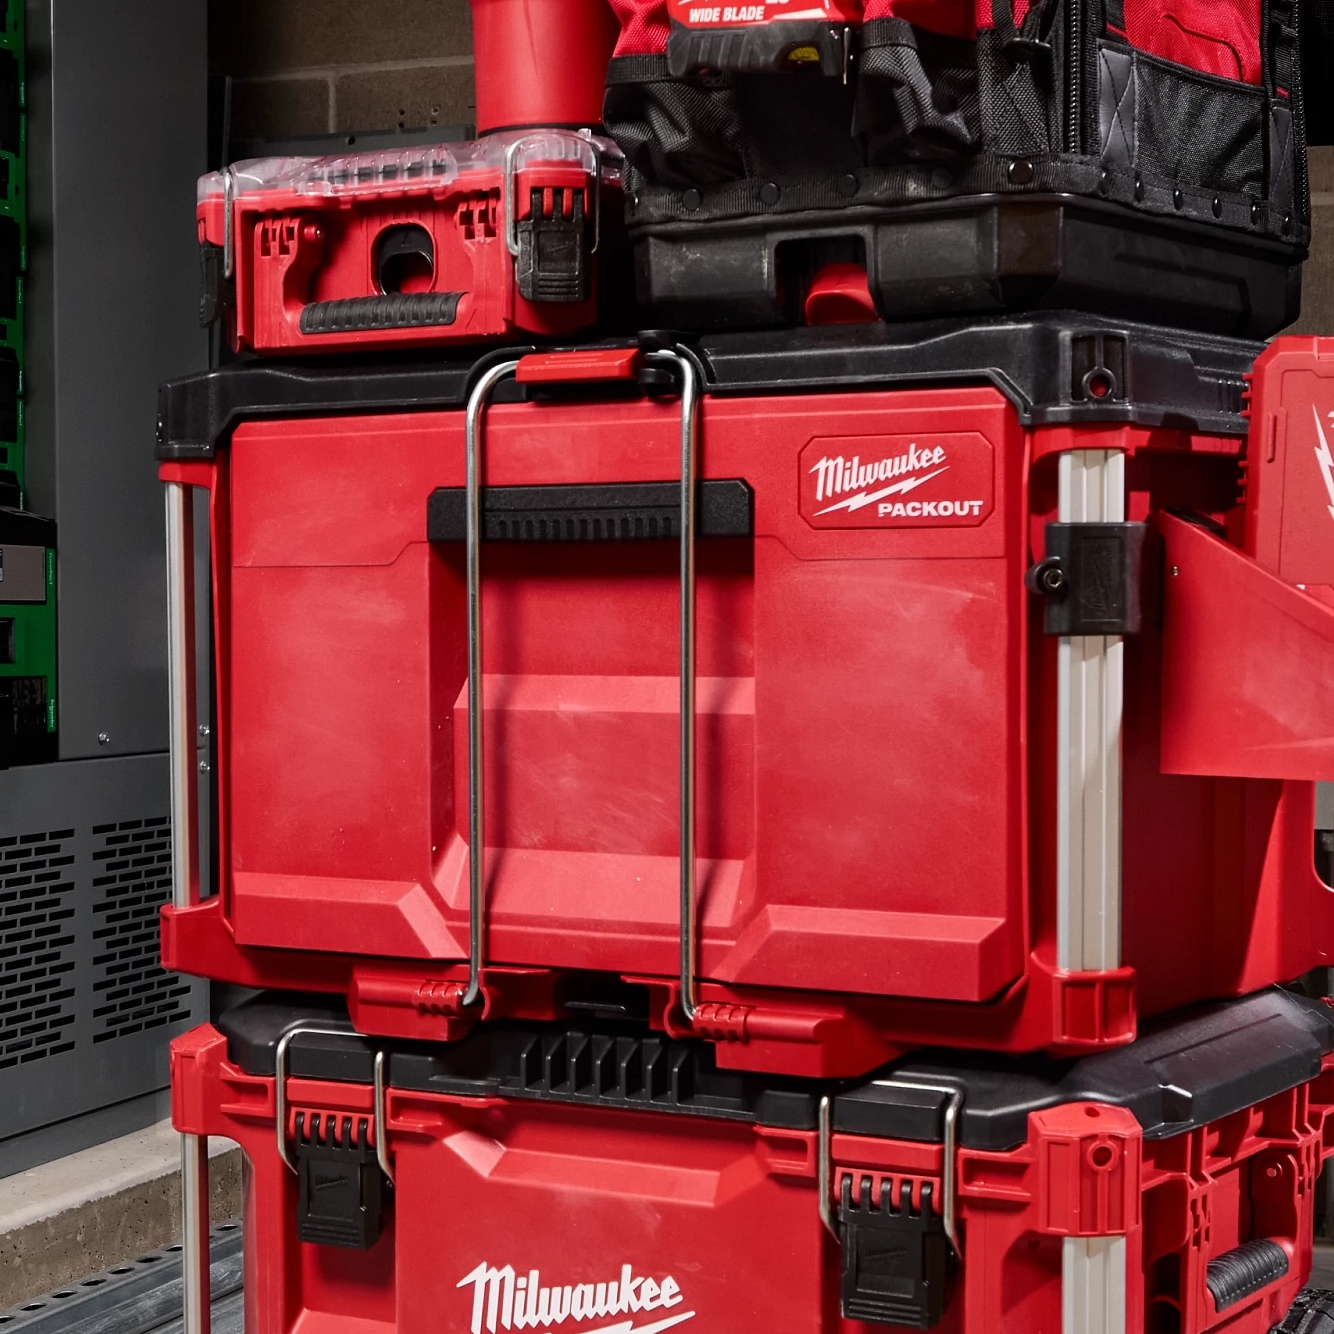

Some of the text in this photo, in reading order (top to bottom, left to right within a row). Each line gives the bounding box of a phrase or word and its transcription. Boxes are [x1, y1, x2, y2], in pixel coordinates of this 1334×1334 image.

[689, 6, 765, 23] WIDE BLADE
[808, 443, 947, 502] Milwaukee
[877, 500, 984, 518] PACKOUT
